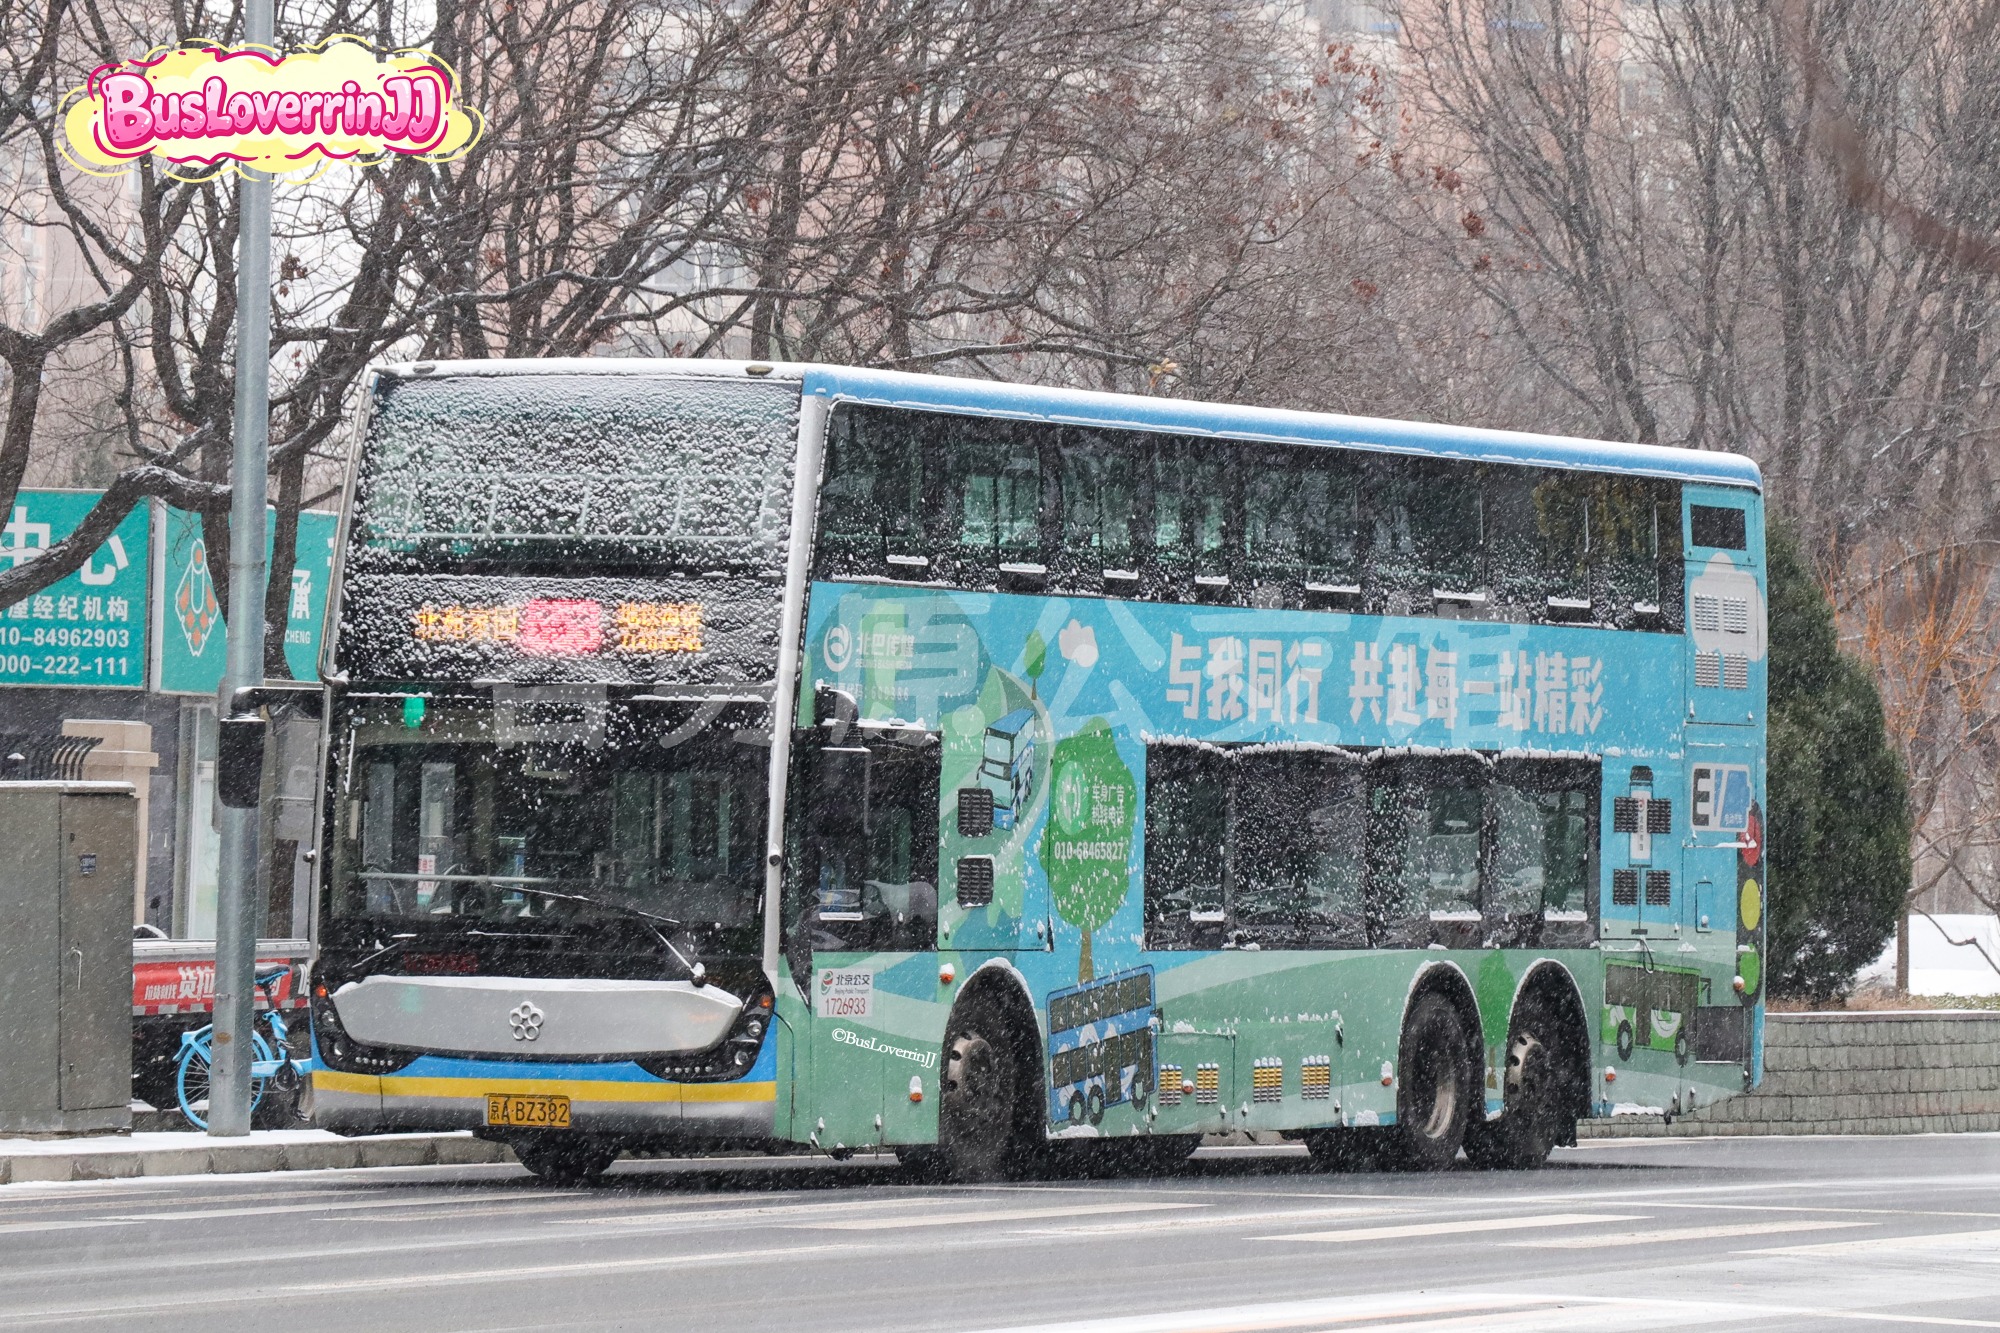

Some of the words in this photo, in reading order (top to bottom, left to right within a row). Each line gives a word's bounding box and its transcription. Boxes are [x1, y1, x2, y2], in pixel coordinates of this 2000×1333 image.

[0, 595, 129, 621] 屋经纪机构
[856, 632, 915, 657] 北巴传媒
[1166, 632, 1323, 723] 与我同行
[1349, 640, 1604, 735] 共赴每一站精彩
[1092, 784, 1125, 802] 车身广告
[1092, 804, 1125, 826] 热线电话
[1054, 841, 1125, 860] 010-68465827
[835, 974, 871, 986] 北京公交
[825, 998, 866, 1015] 1726933
